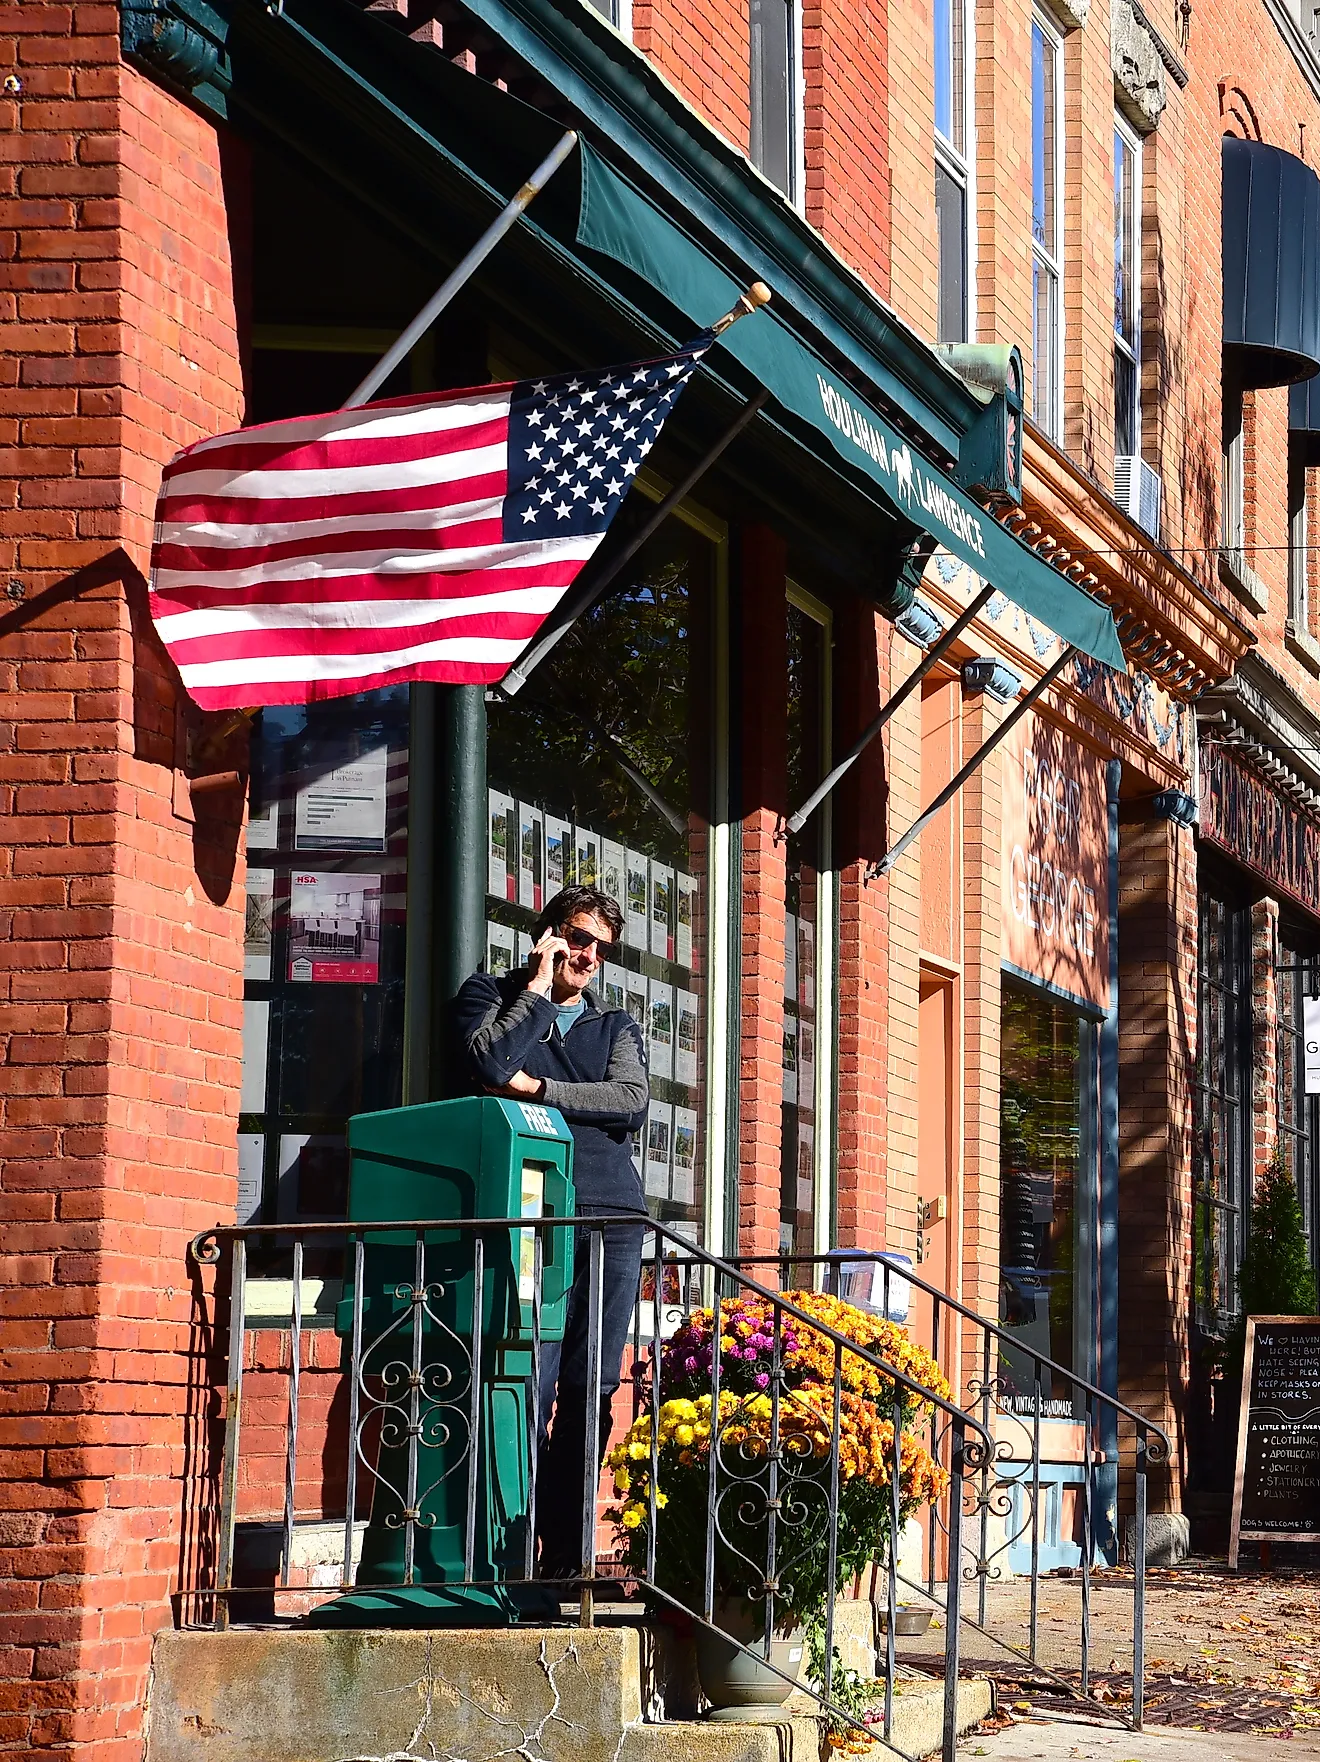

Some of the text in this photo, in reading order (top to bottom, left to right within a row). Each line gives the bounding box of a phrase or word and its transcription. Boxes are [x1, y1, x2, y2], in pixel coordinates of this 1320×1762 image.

[817, 373, 986, 558] HOULIHAN LAWRENCE
[1024, 747, 1081, 853] POOR
[296, 876, 317, 884] HSA
[1010, 844, 1094, 957] GEORGE
[517, 1102, 559, 1136] FREE
[1258, 1334, 1274, 1346] WE
[1269, 1347, 1301, 1356] HERE!
[1303, 1347, 1320, 1355] BUT
[1259, 1359, 1284, 1367] HATE
[1288, 1358, 1320, 1367] SEEING
[1258, 1368, 1286, 1377] NOSE
[1257, 1380, 1279, 1388] KEEP
[1279, 1380, 1311, 1389] MASKS
[1257, 1390, 1312, 1400] IN STORES.
[1014, 1395, 1036, 1413] VINTAG
[1043, 1399, 1073, 1417] HANDMADE
[1270, 1436, 1319, 1448] CLOTHING
[1268, 1463, 1308, 1475] JEWELRY
[1263, 1489, 1300, 1500] PLANTS
[1241, 1519, 1303, 1528] DOGS WELCOME!
